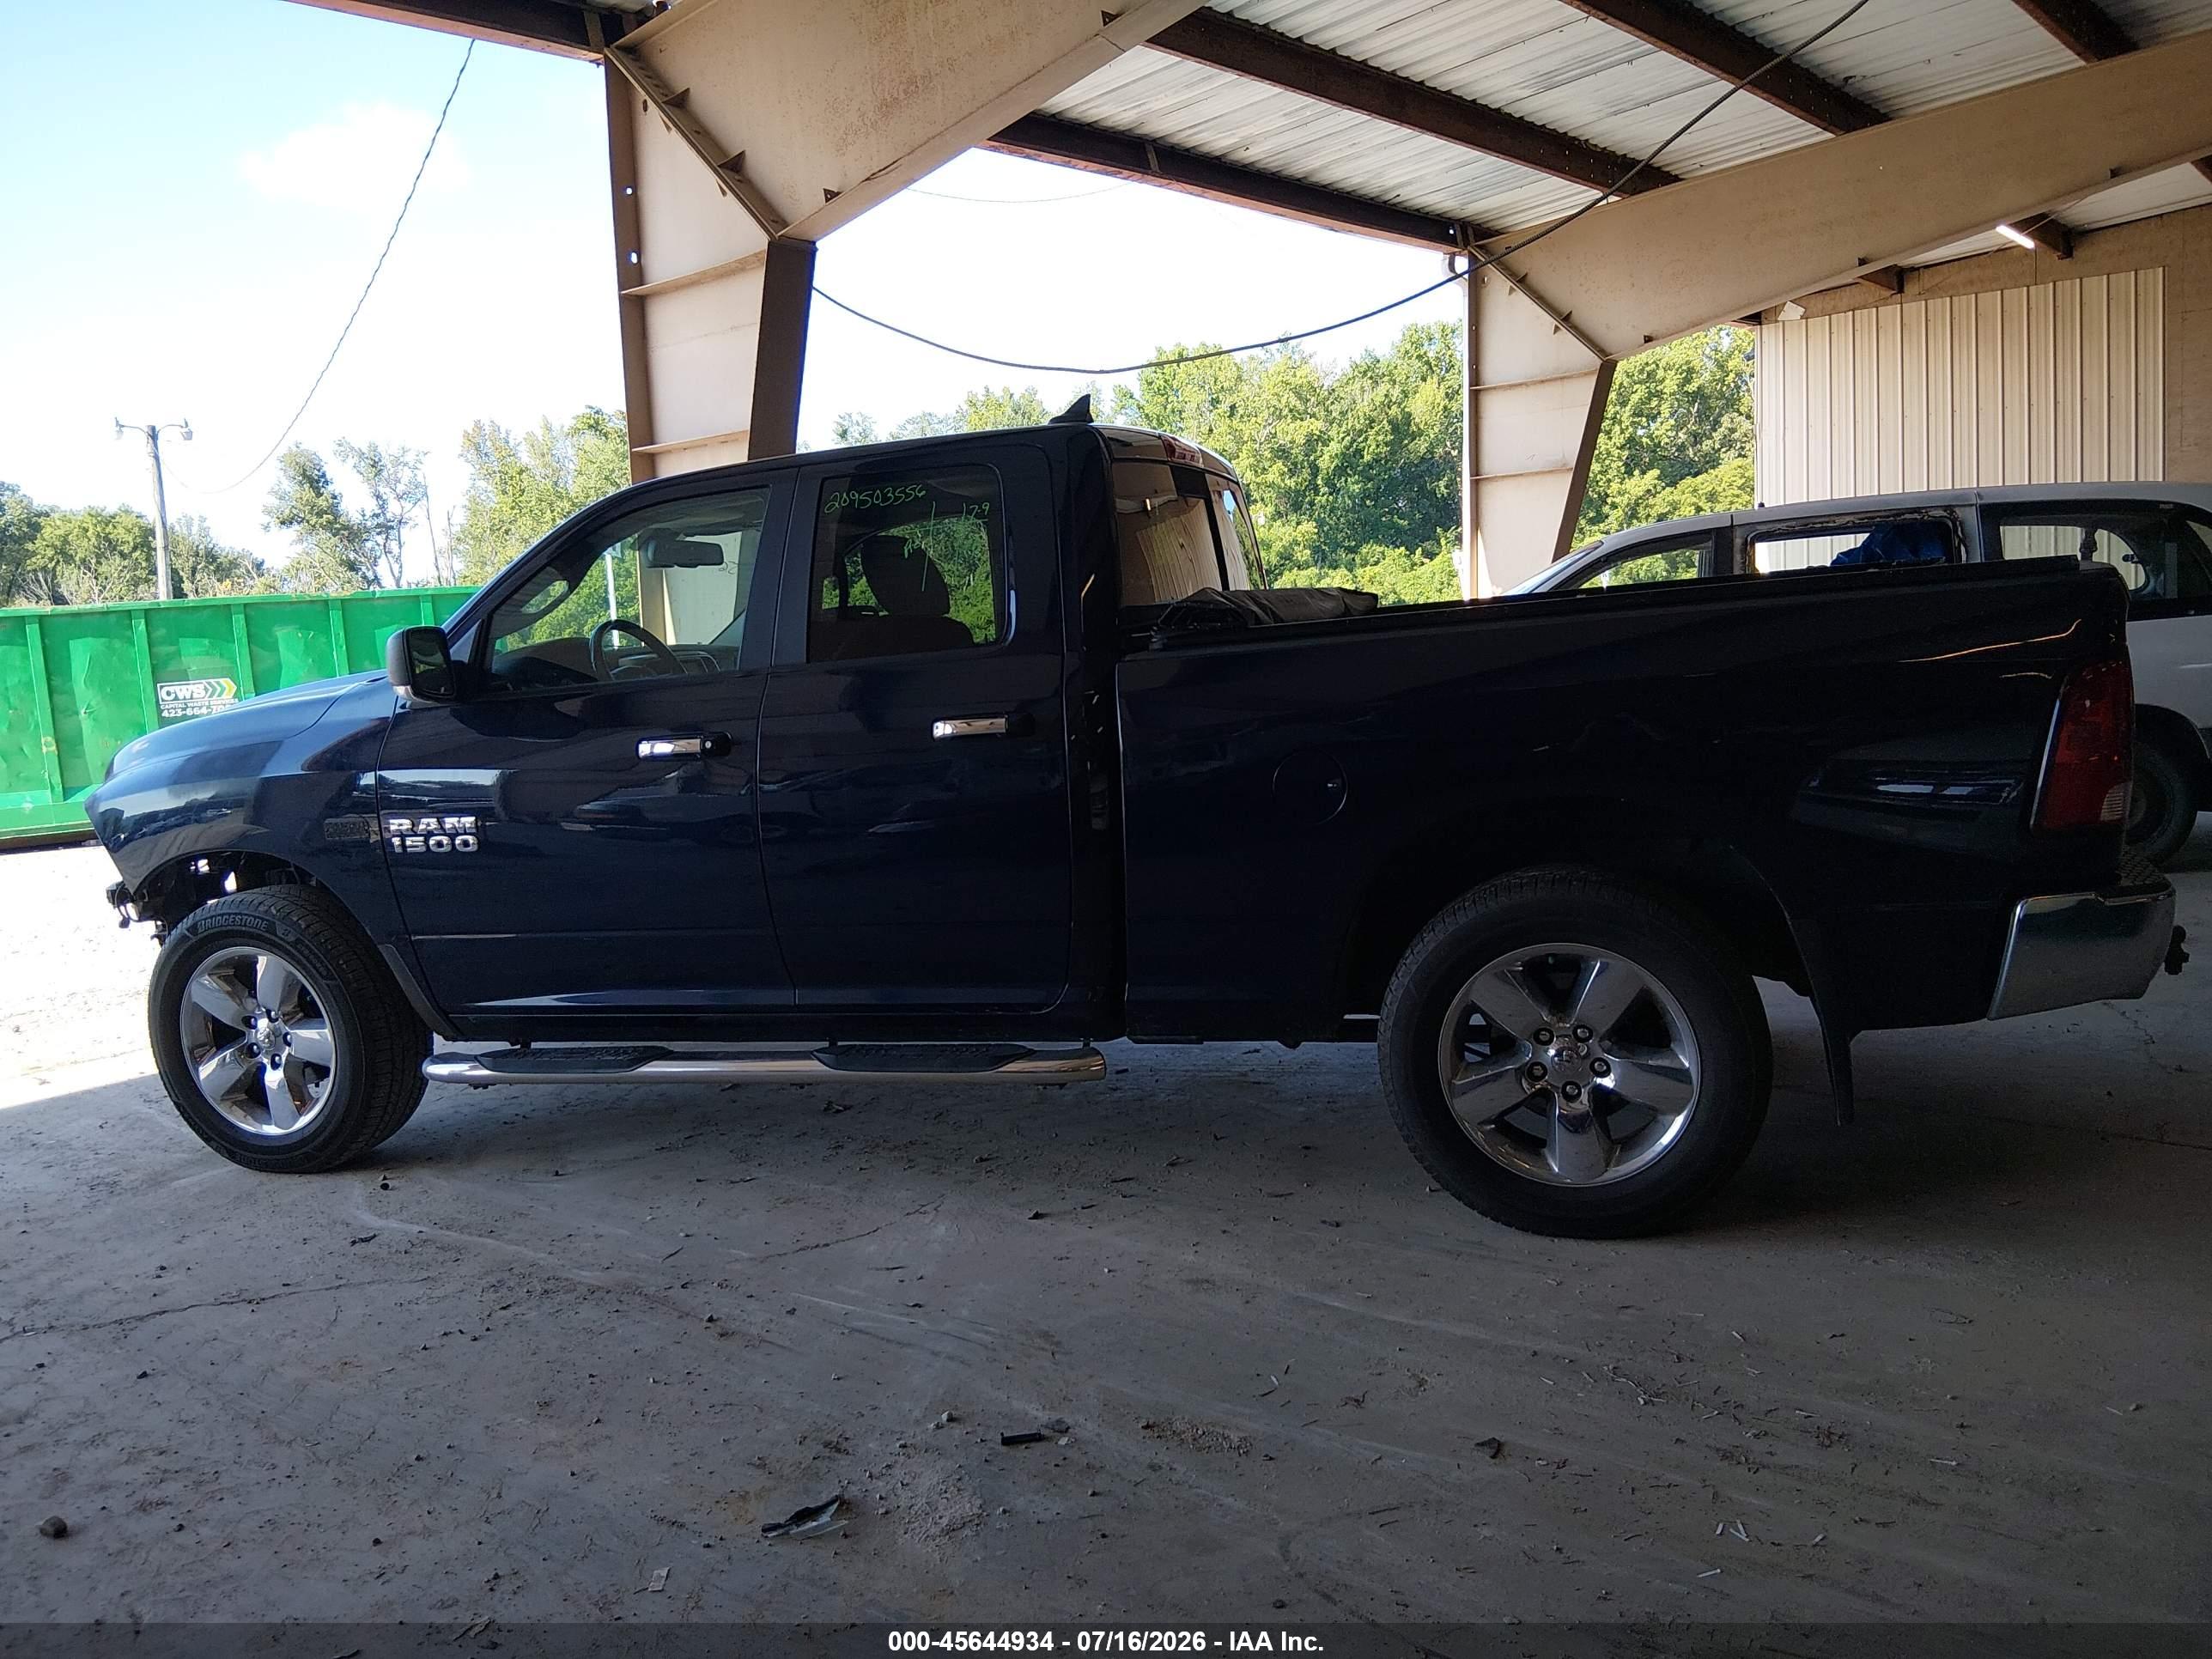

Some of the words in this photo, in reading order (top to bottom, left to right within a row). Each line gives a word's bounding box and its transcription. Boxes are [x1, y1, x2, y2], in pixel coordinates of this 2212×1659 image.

[161, 684, 206, 701] CWS
[161, 704, 232, 718] 423-664-70
[388, 816, 477, 836] RAM
[391, 835, 479, 854] 1500
[197, 914, 269, 933] BRIDGESTONE
